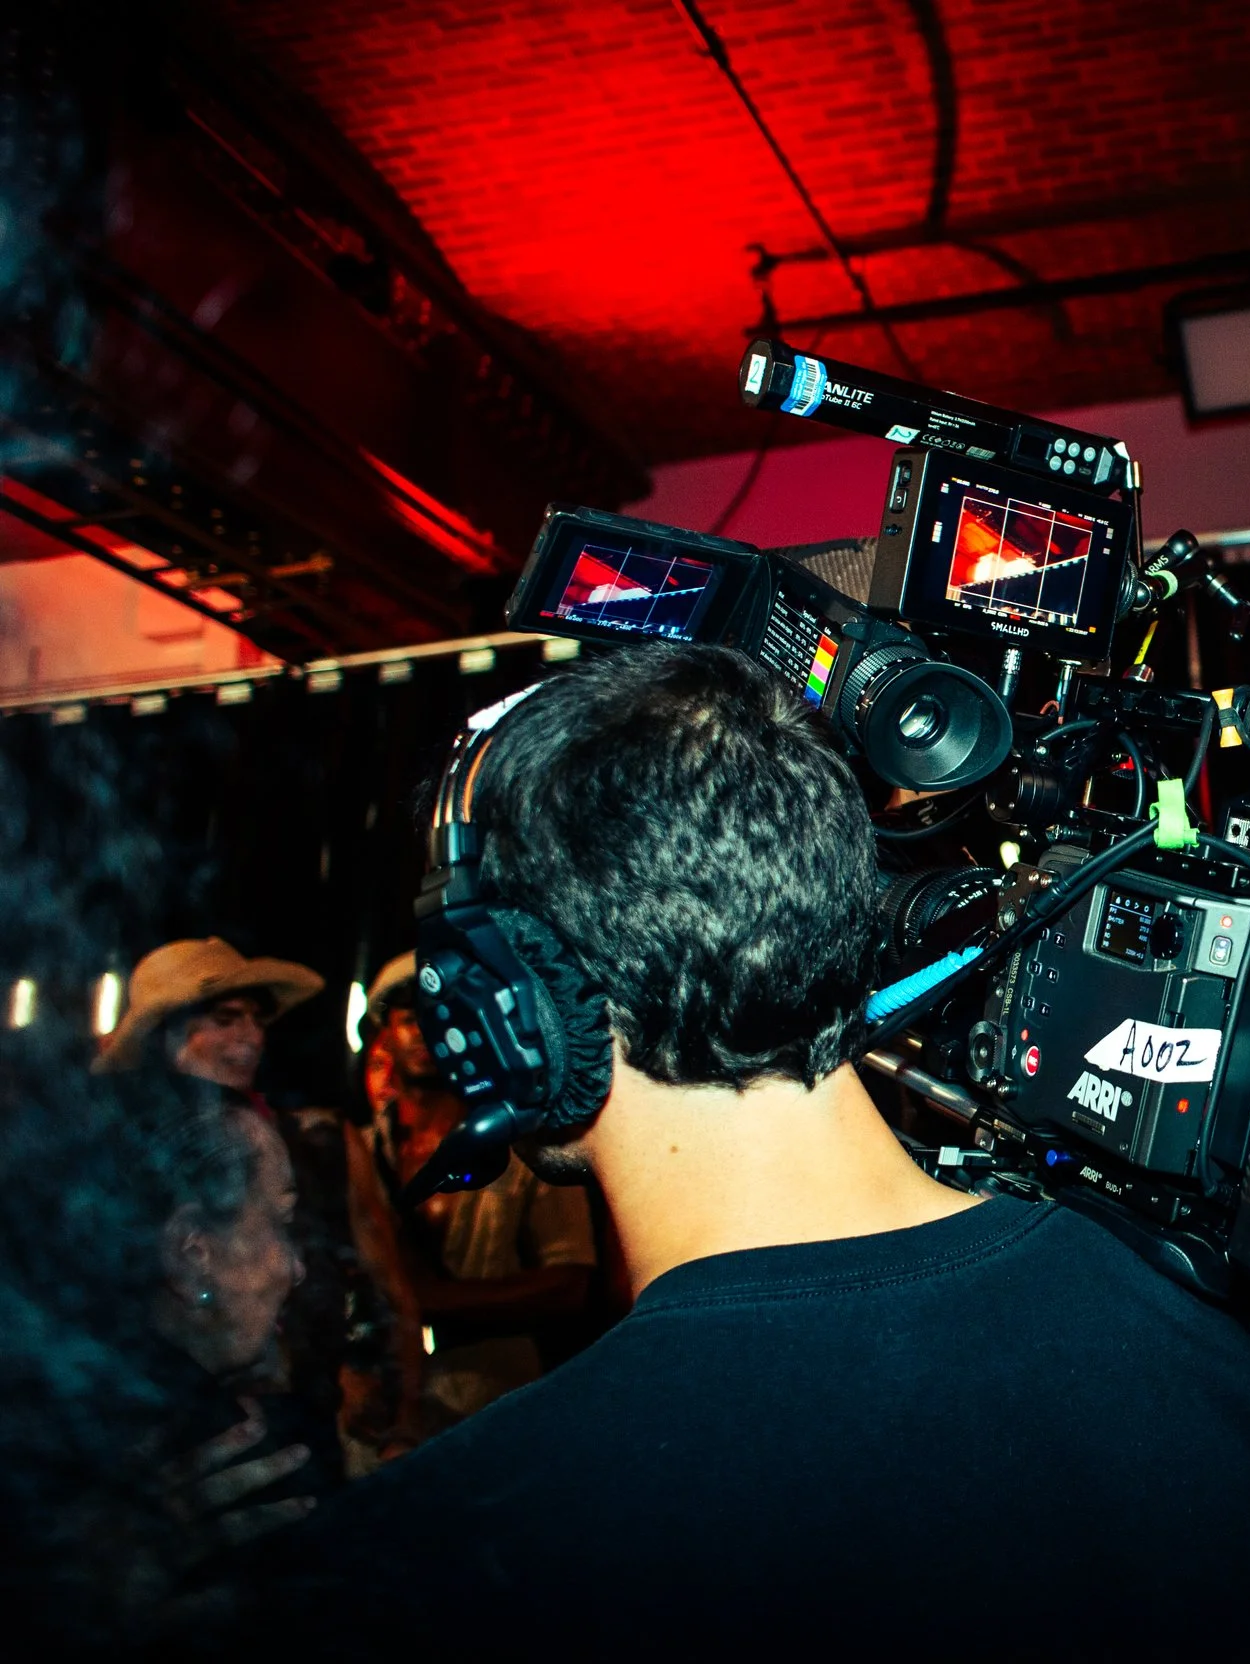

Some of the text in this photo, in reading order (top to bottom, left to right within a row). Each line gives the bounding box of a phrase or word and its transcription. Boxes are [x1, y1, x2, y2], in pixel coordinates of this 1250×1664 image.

[749, 361, 760, 384] 2
[823, 381, 875, 404] ANLITE
[991, 621, 1030, 637] SMALLHD
[1119, 1021, 1208, 1074] A002
[1080, 1165, 1099, 1183] ARRI
